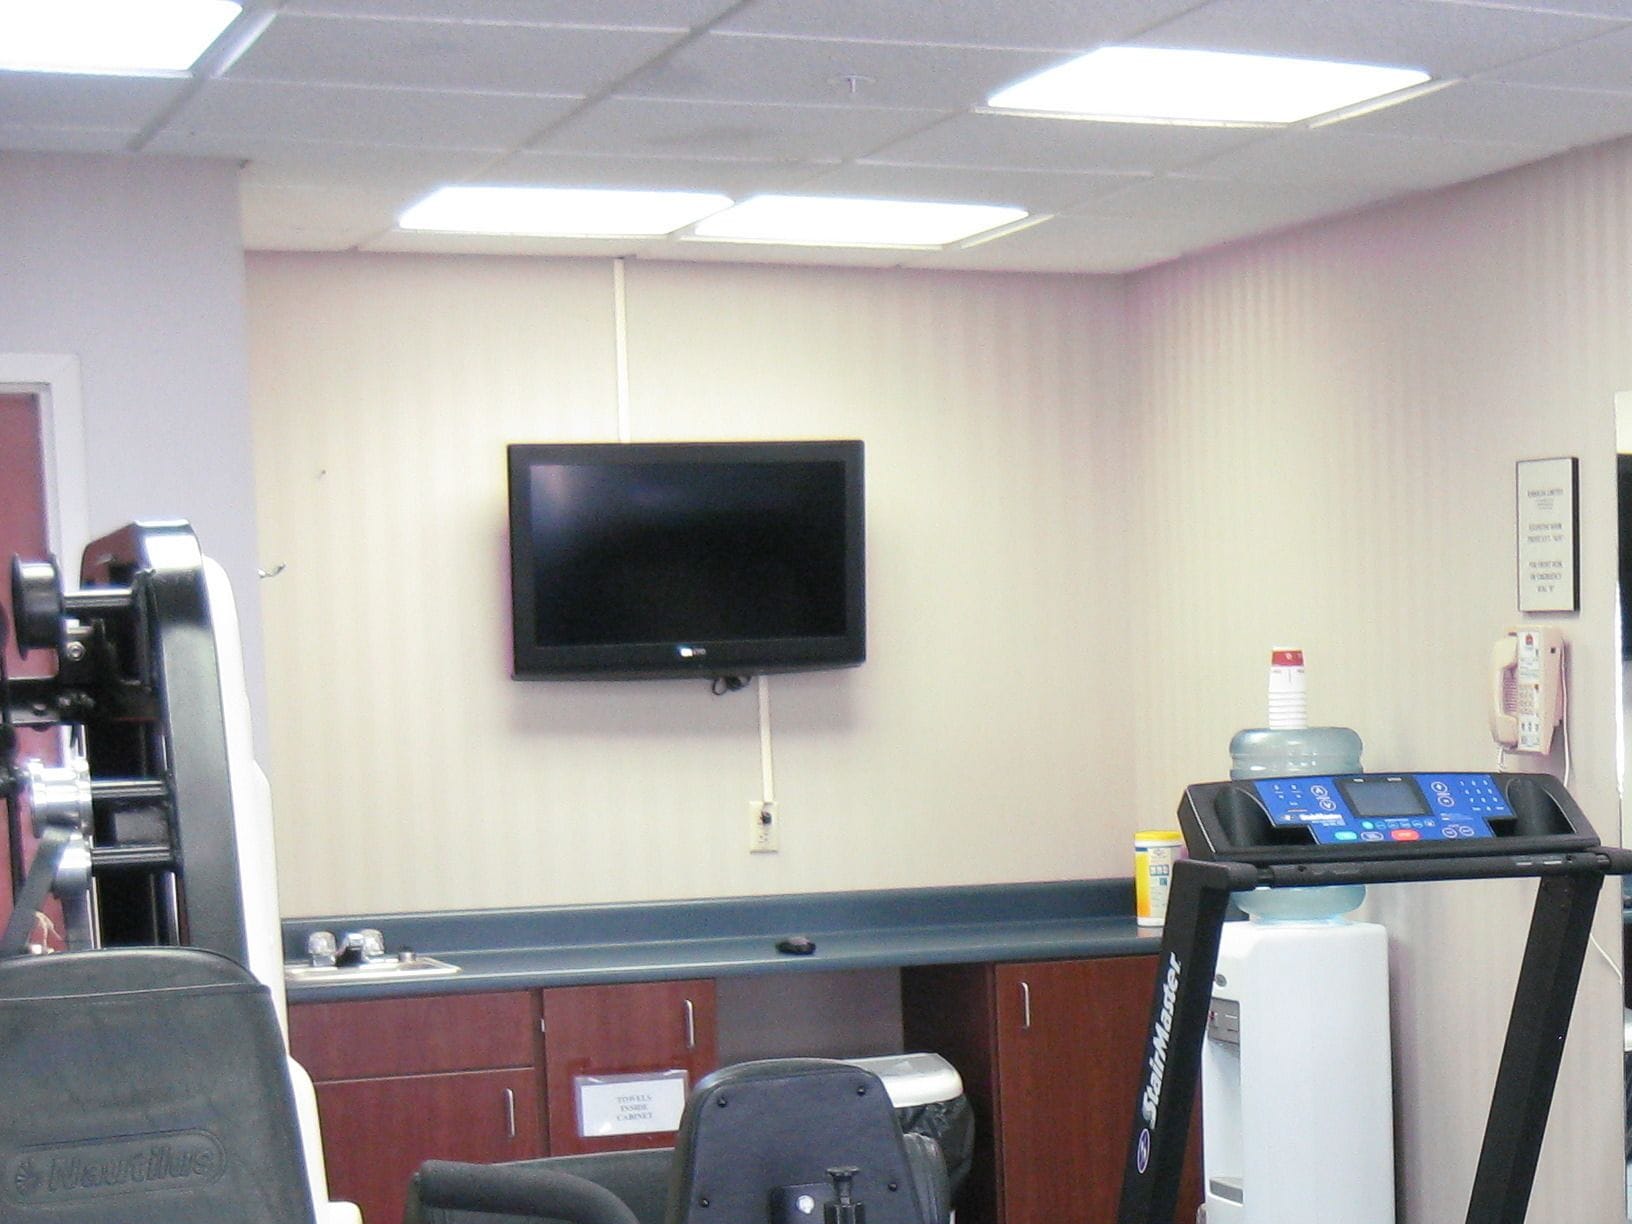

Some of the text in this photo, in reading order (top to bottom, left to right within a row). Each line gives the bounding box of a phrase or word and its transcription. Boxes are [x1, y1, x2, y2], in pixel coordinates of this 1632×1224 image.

[1142, 952, 1182, 1129] StairMaster
[617, 1095, 653, 1104] TOWELS
[617, 1111, 652, 1121] CABINET
